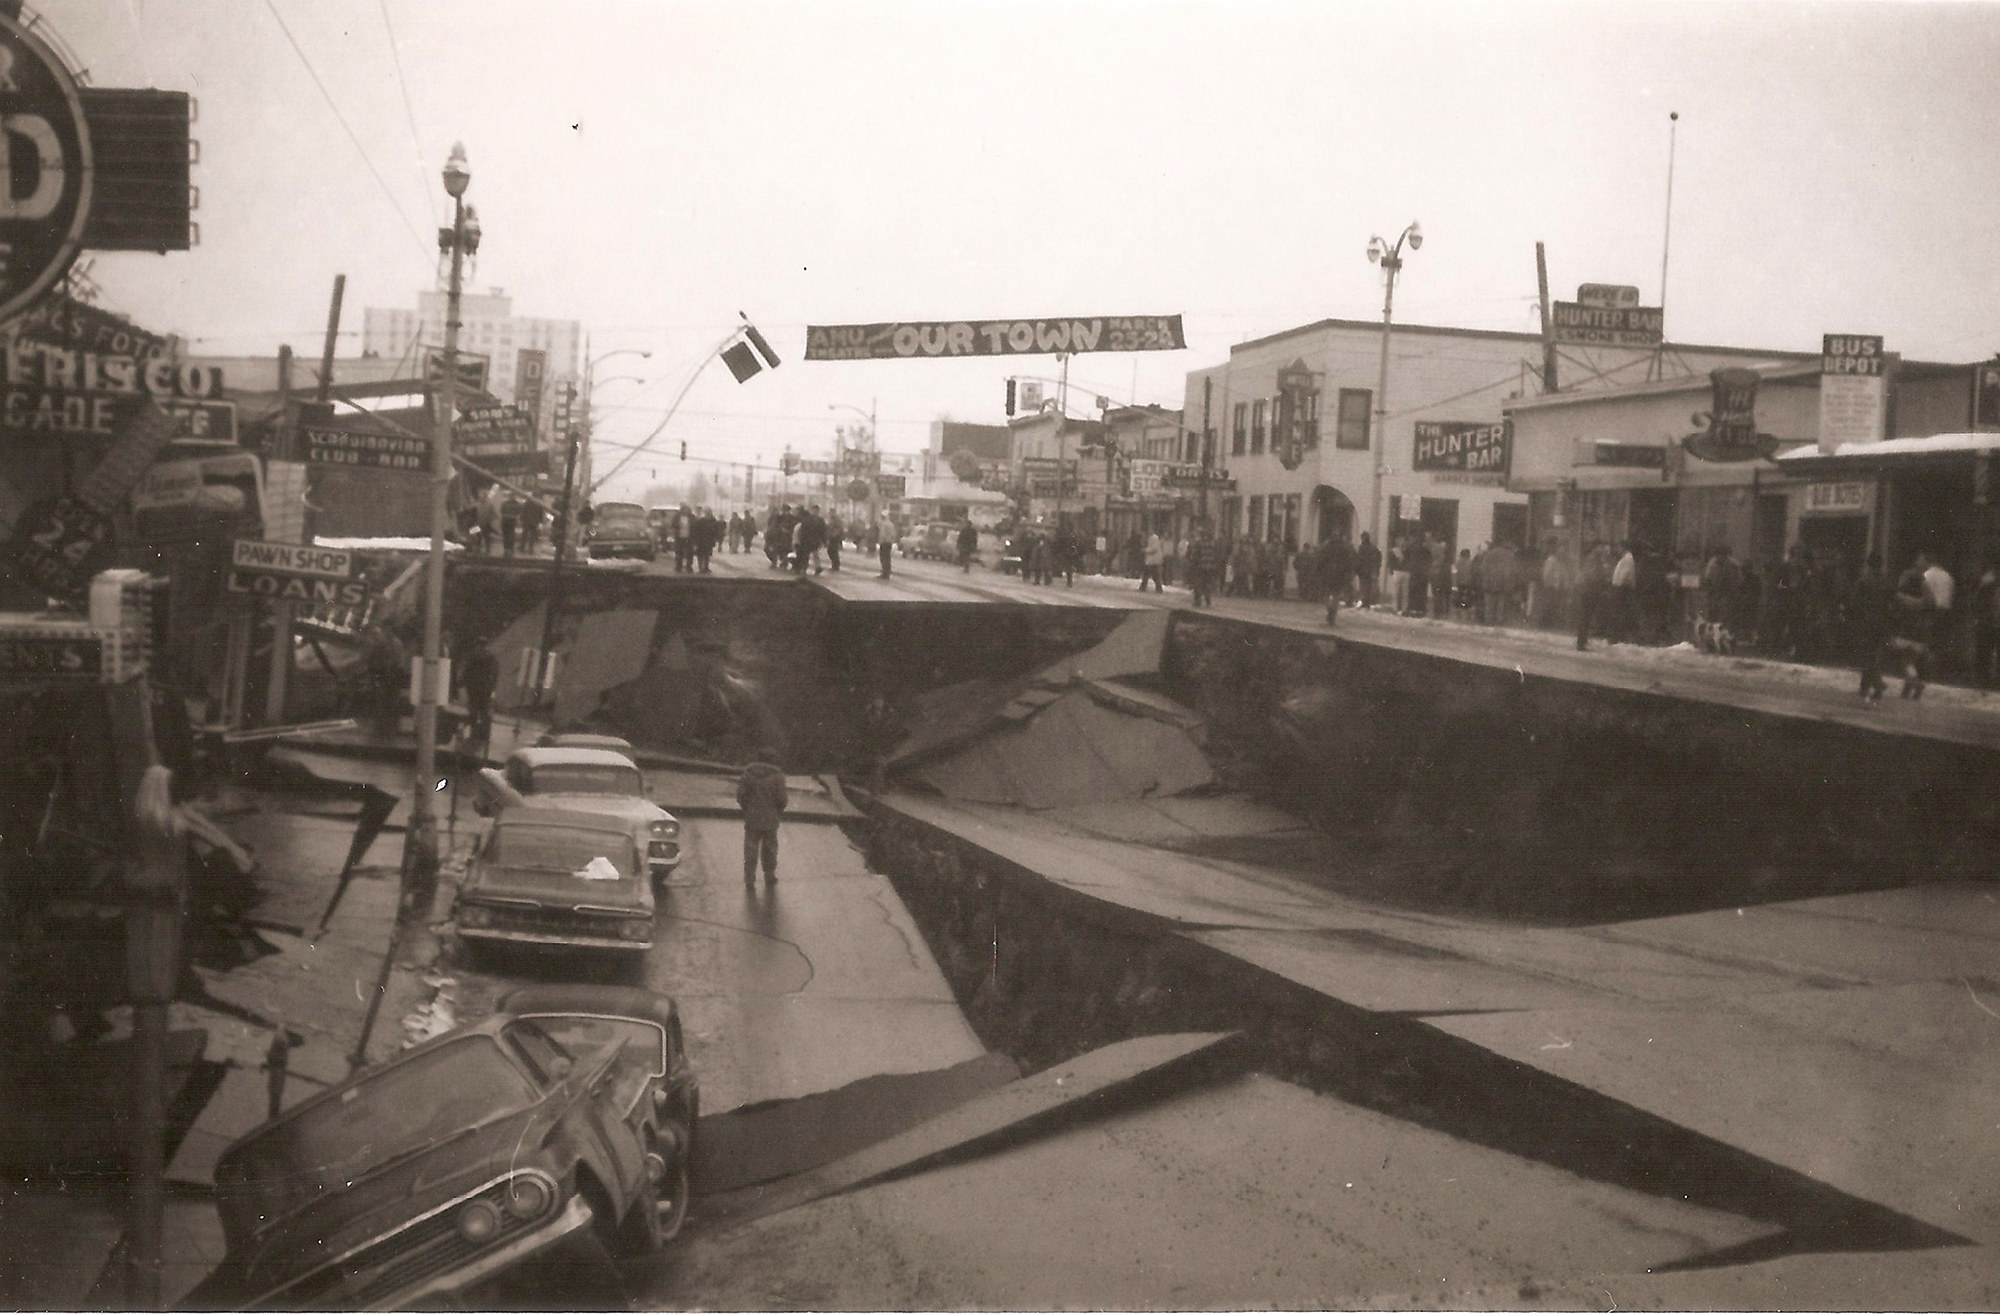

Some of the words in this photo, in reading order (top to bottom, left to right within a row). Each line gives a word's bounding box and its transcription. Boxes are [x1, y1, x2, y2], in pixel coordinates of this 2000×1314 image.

[1109, 316, 1169, 331] MARCH
[1557, 307, 1624, 330] HUNTER
[1628, 311, 1663, 332] BAR
[808, 328, 866, 347] AMU
[892, 323, 974, 356] OUR
[980, 318, 1102, 352] TOWN
[1830, 338, 1876, 355] BUS
[1824, 356, 1882, 374] DEPOT
[1418, 423, 1441, 437] THE
[1418, 424, 1504, 461] HUNTER
[310, 447, 359, 464] CLUB
[1466, 446, 1503, 469] BAR
[239, 542, 292, 566] PAWN
[295, 549, 347, 572] SHOP
[227, 571, 364, 604] LOANS
